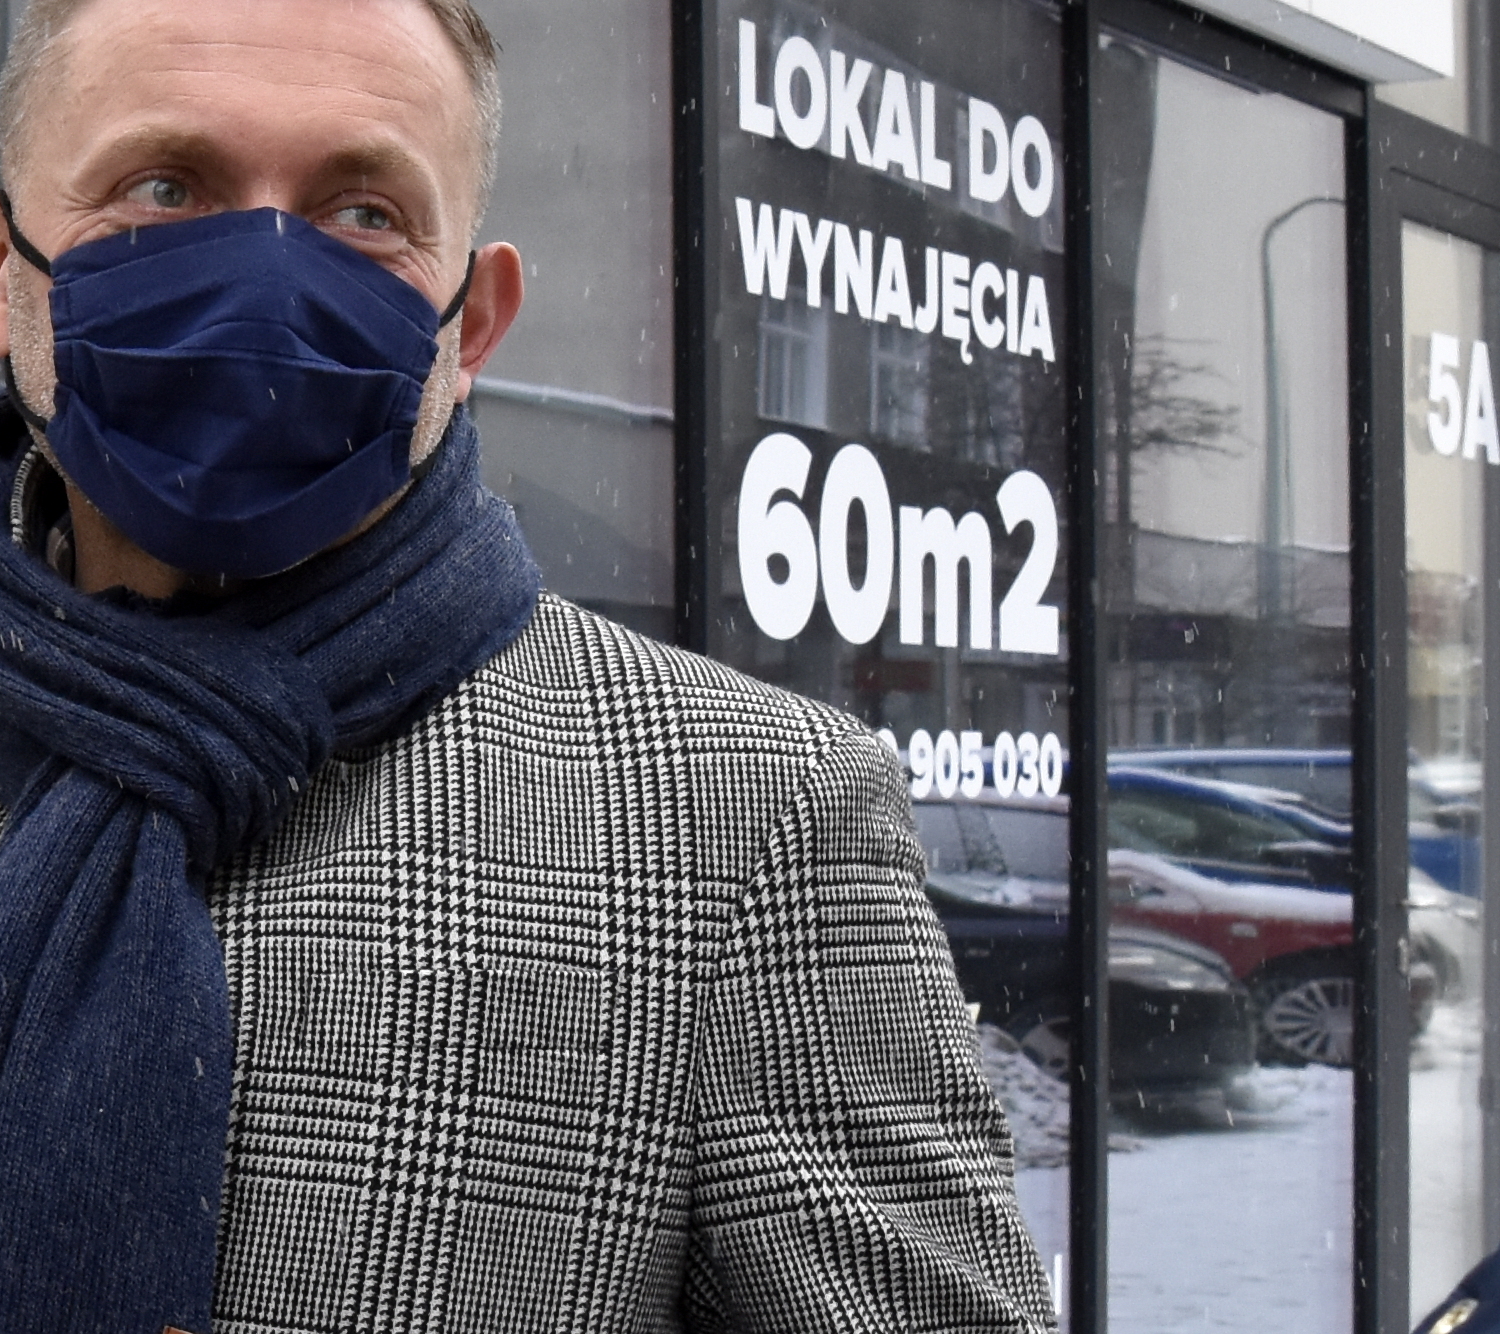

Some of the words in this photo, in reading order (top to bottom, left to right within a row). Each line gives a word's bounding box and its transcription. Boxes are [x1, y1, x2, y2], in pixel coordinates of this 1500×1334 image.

[738, 18, 952, 191] LOKAL
[968, 96, 1055, 218] DO
[735, 196, 1056, 365] WYNAJĘCIA
[737, 432, 1060, 656] 60m2
[908, 728, 985, 799] 905
[992, 731, 1063, 799] 030
